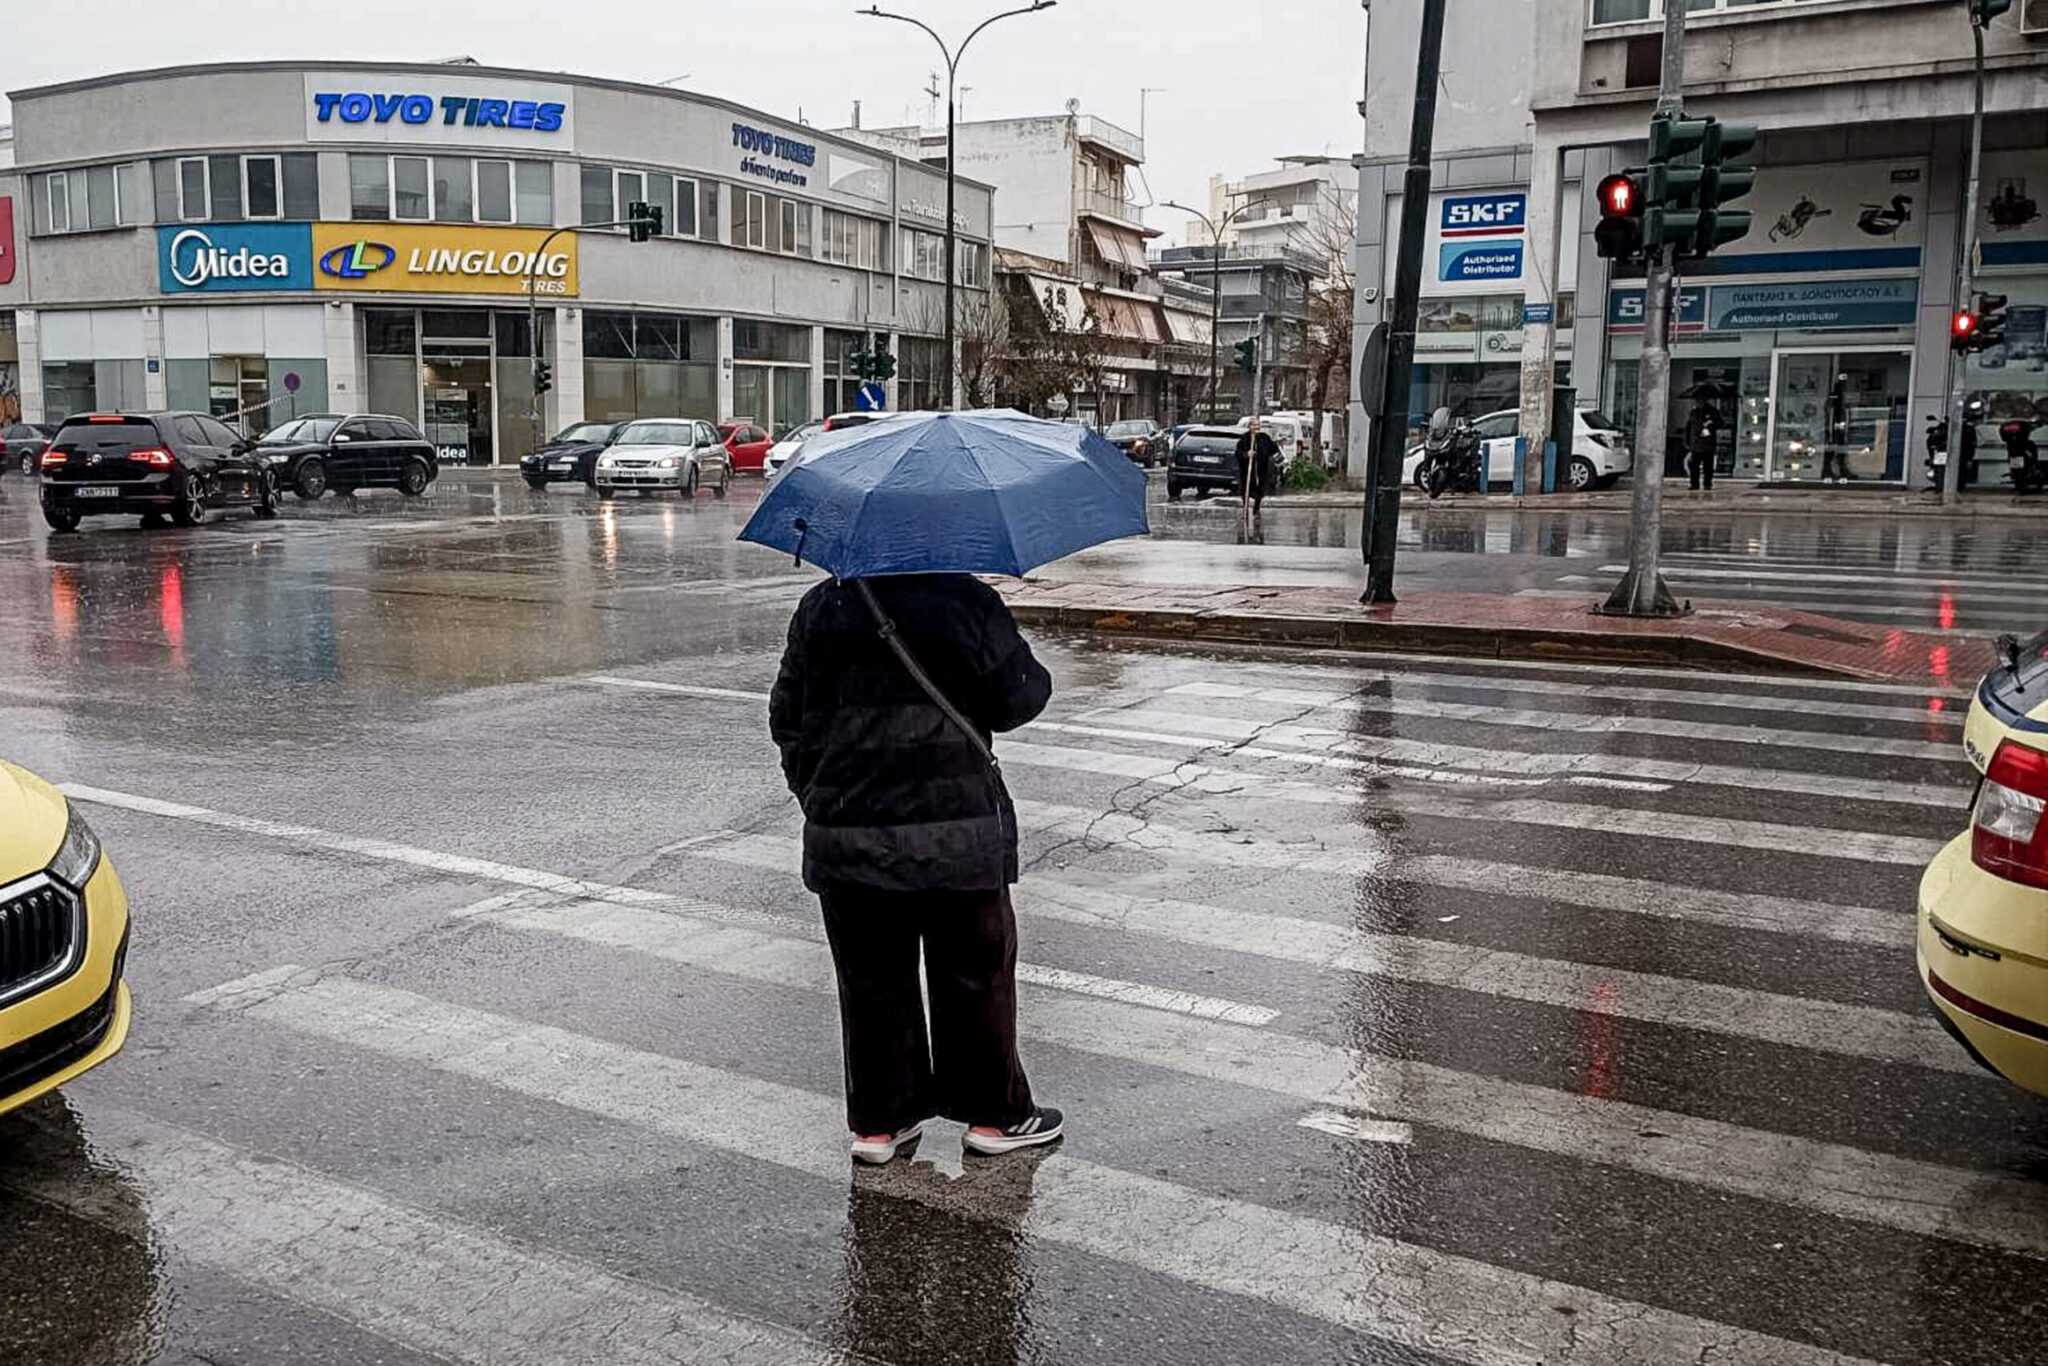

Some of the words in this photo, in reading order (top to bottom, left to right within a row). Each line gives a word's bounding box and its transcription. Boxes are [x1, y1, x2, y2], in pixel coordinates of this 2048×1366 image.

[315, 93, 433, 123] TOYO
[440, 97, 565, 131] TIRES
[732, 123, 773, 155] TOYO
[774, 136, 816, 167] TIRES
[1448, 202, 1520, 223] SKF
[174, 235, 289, 282] Midea
[407, 248, 570, 277] LINGLONG
[1463, 265, 1516, 274] Distributor
[520, 280, 567, 293] TRES
[1618, 294, 1698, 317] SF
